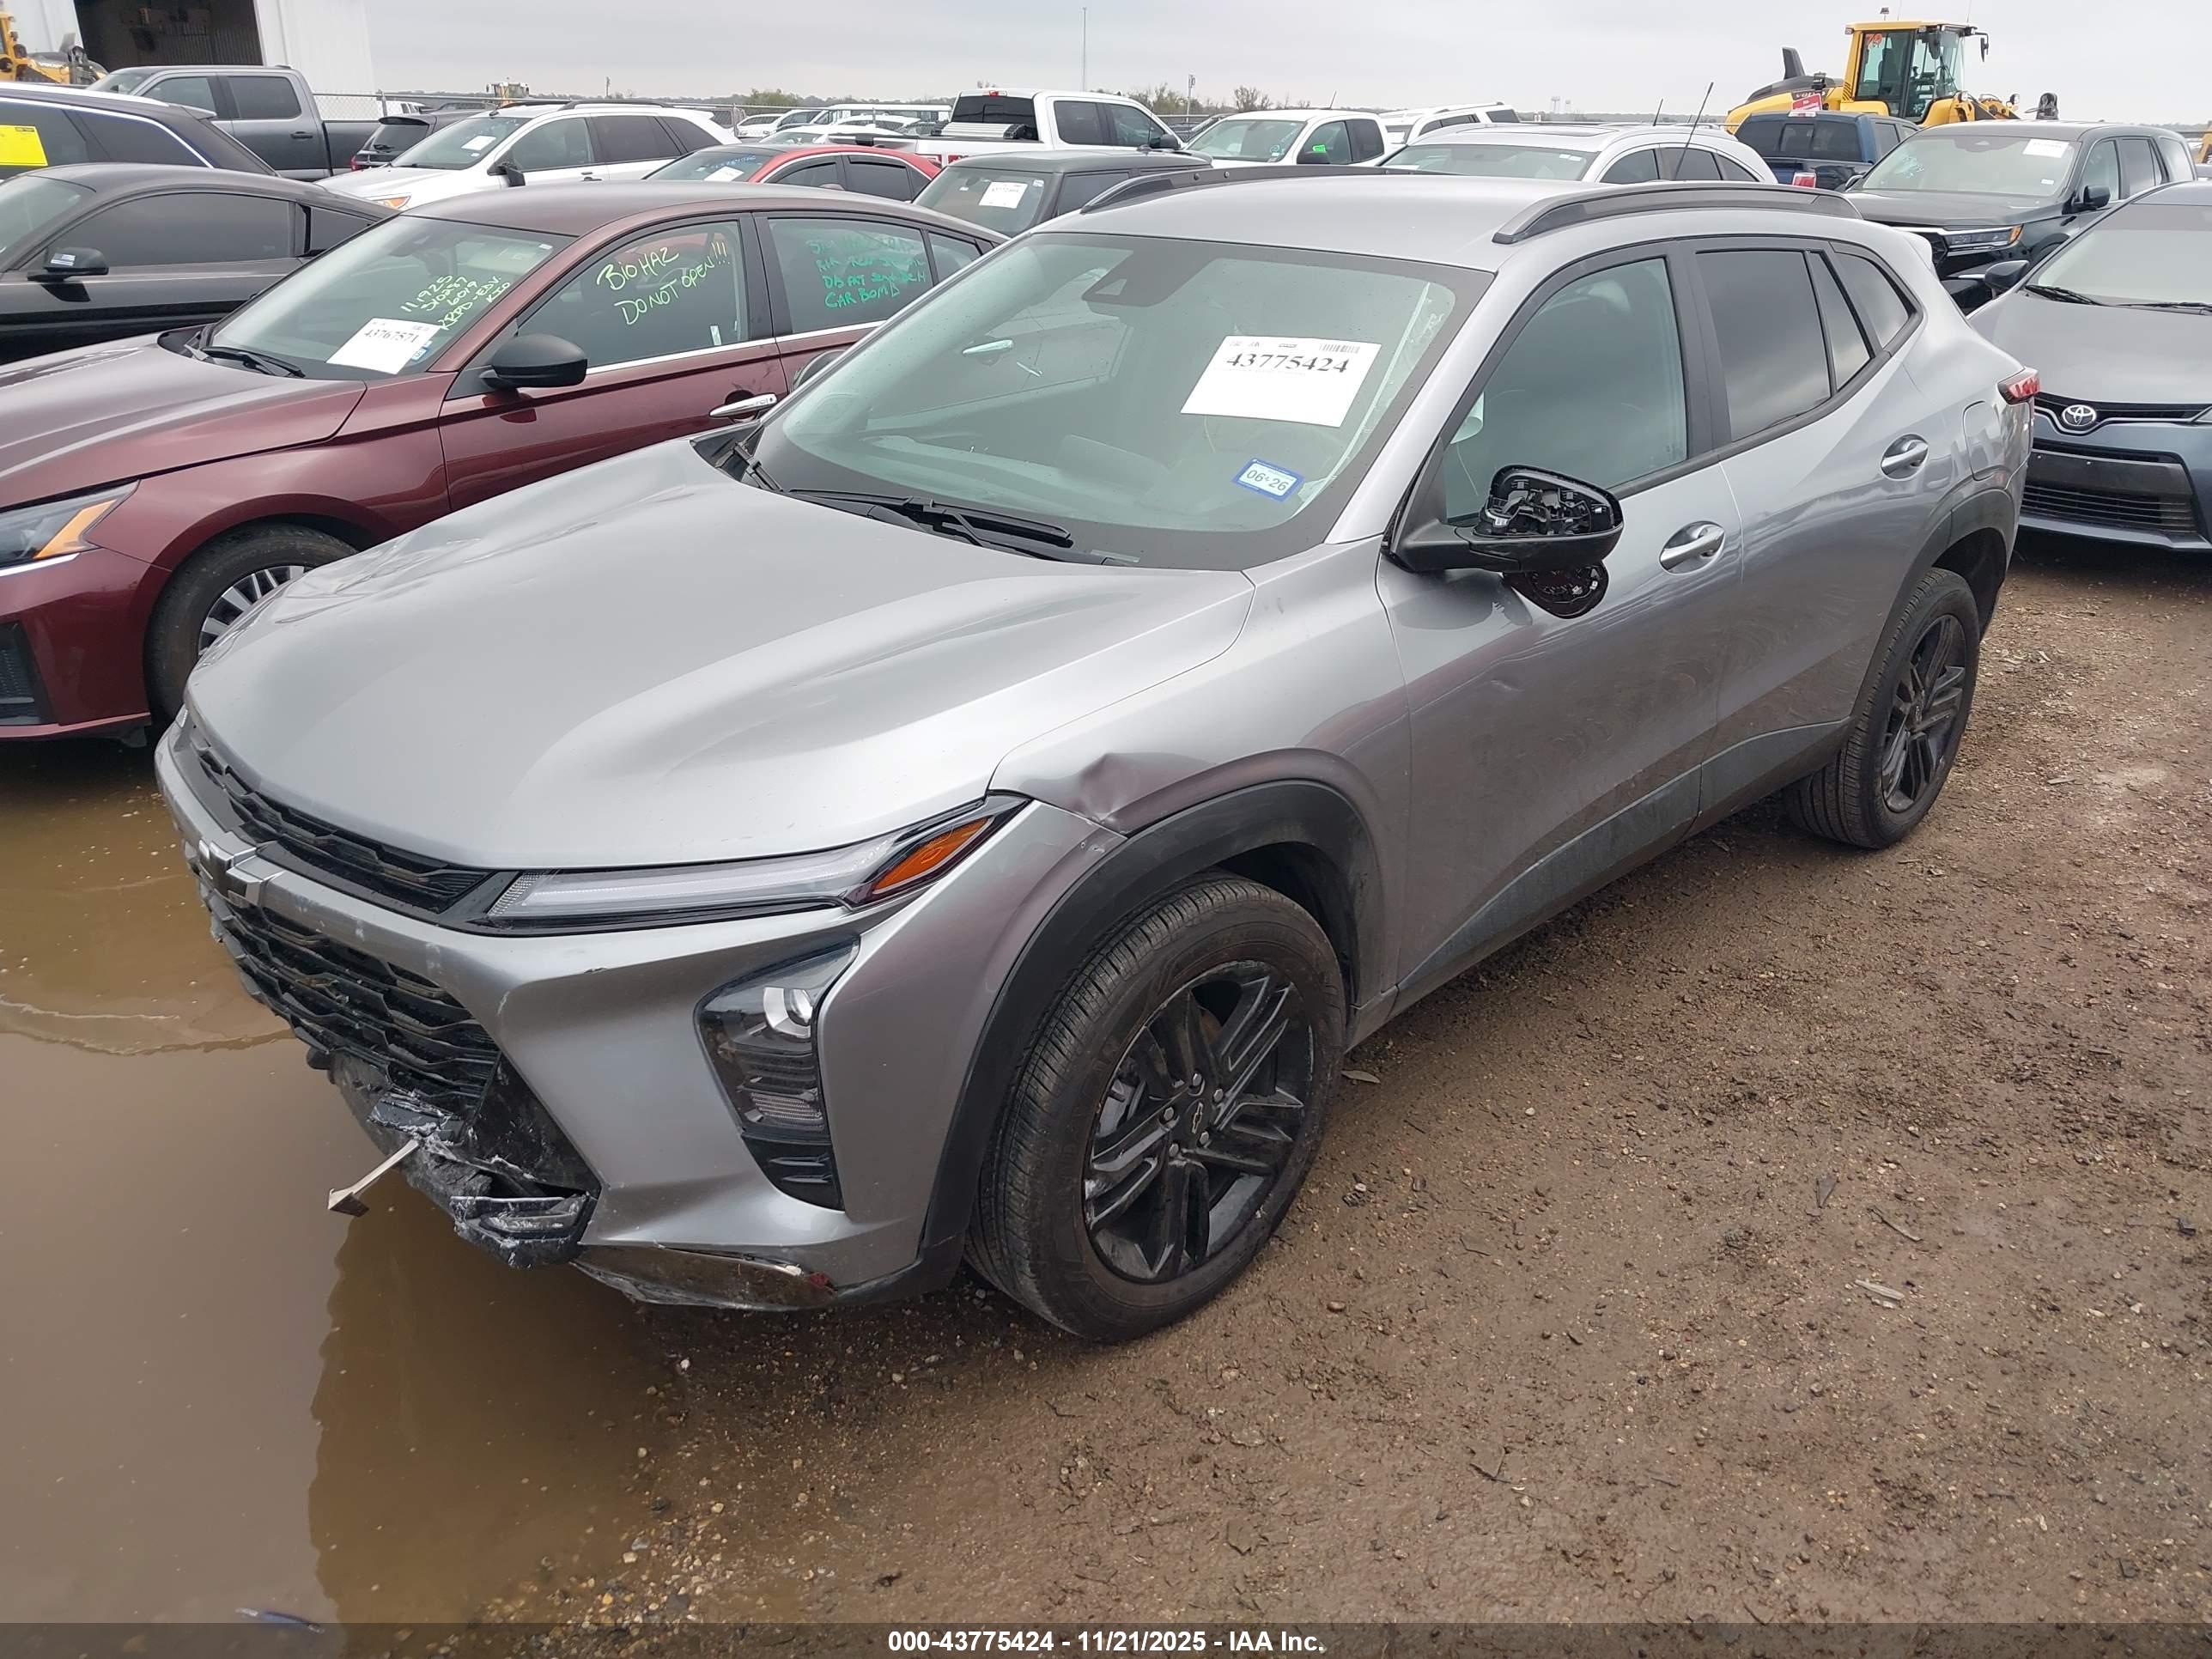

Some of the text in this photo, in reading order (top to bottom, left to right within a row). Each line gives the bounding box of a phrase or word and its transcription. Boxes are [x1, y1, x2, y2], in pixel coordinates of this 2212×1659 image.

[648, 278, 680, 309] NOT
[824, 291, 857, 308] CAR
[1226, 352, 1350, 374] 43775424
[1247, 470, 1266, 482] 06
[1269, 478, 1289, 490] 26
